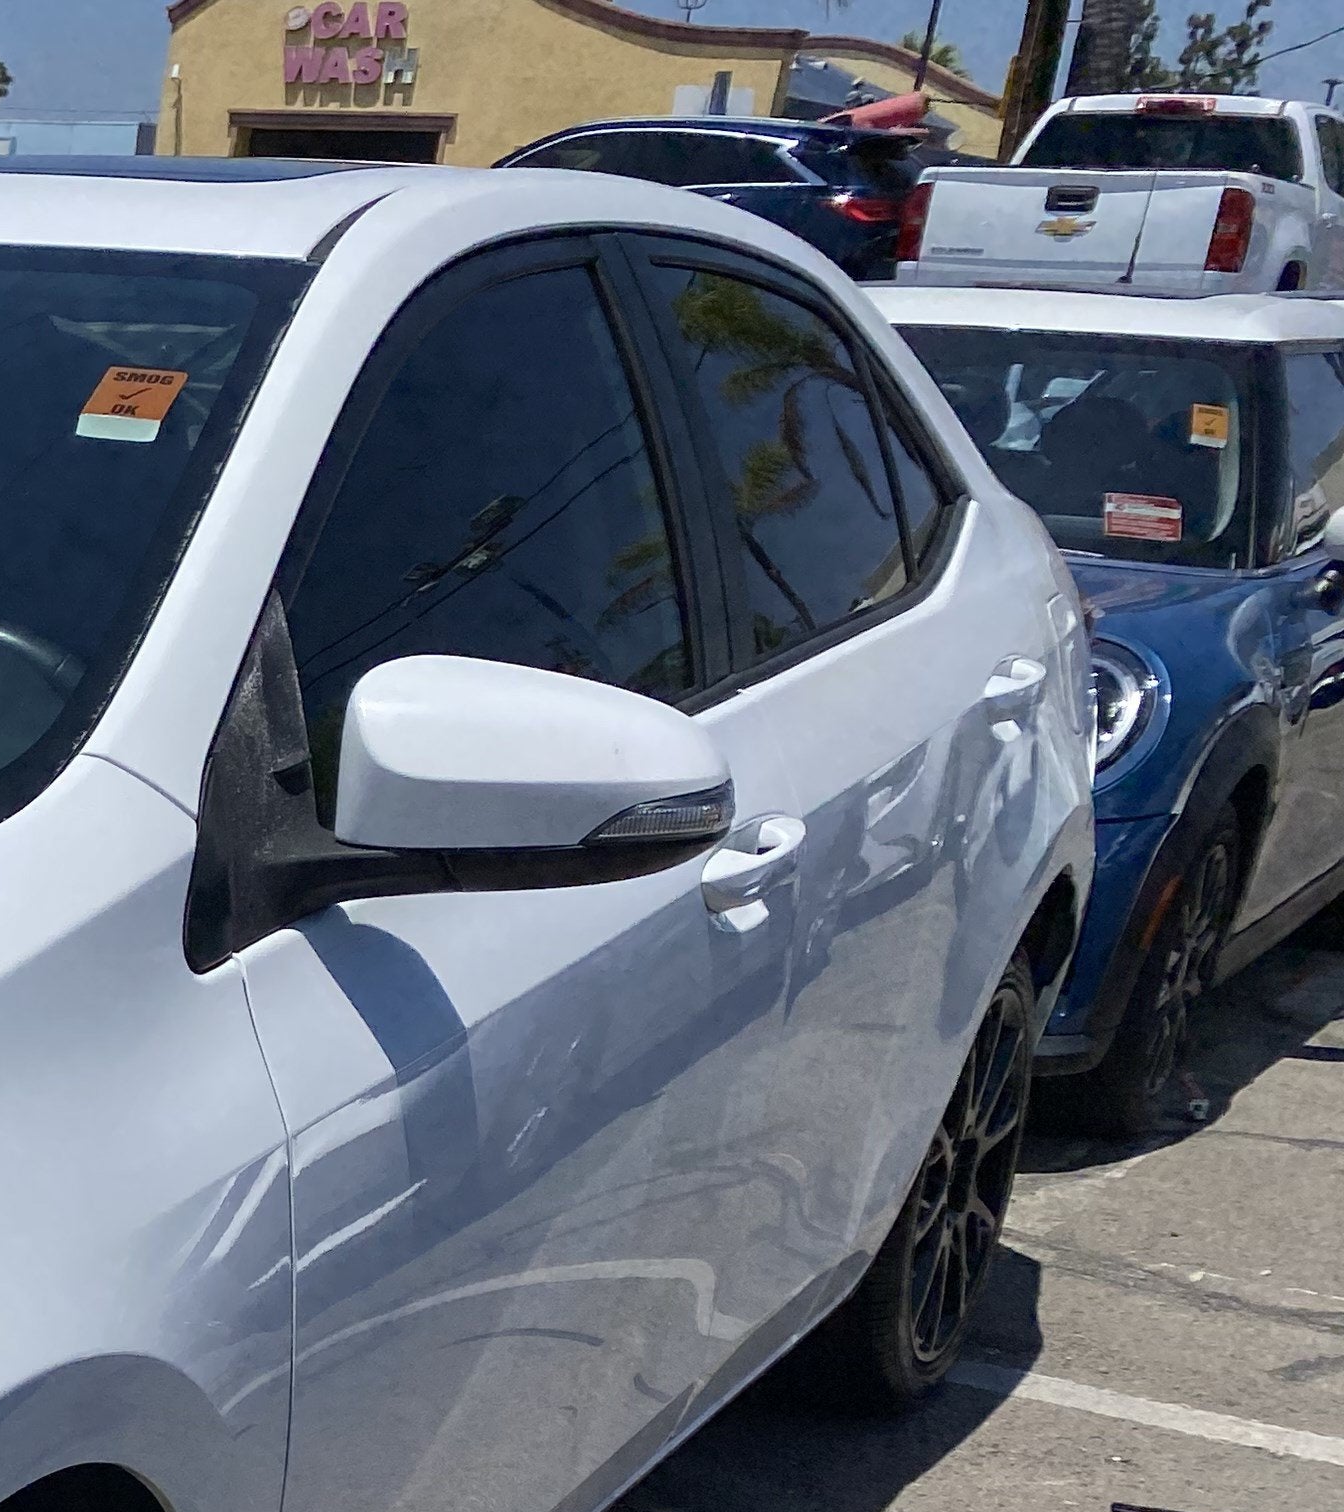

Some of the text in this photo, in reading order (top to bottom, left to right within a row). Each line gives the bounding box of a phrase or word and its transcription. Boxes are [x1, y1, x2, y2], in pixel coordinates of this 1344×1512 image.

[312, 1, 409, 39] CAR
[283, 46, 419, 84] WASH
[113, 371, 175, 386] SMOG
[111, 403, 139, 416] OK
